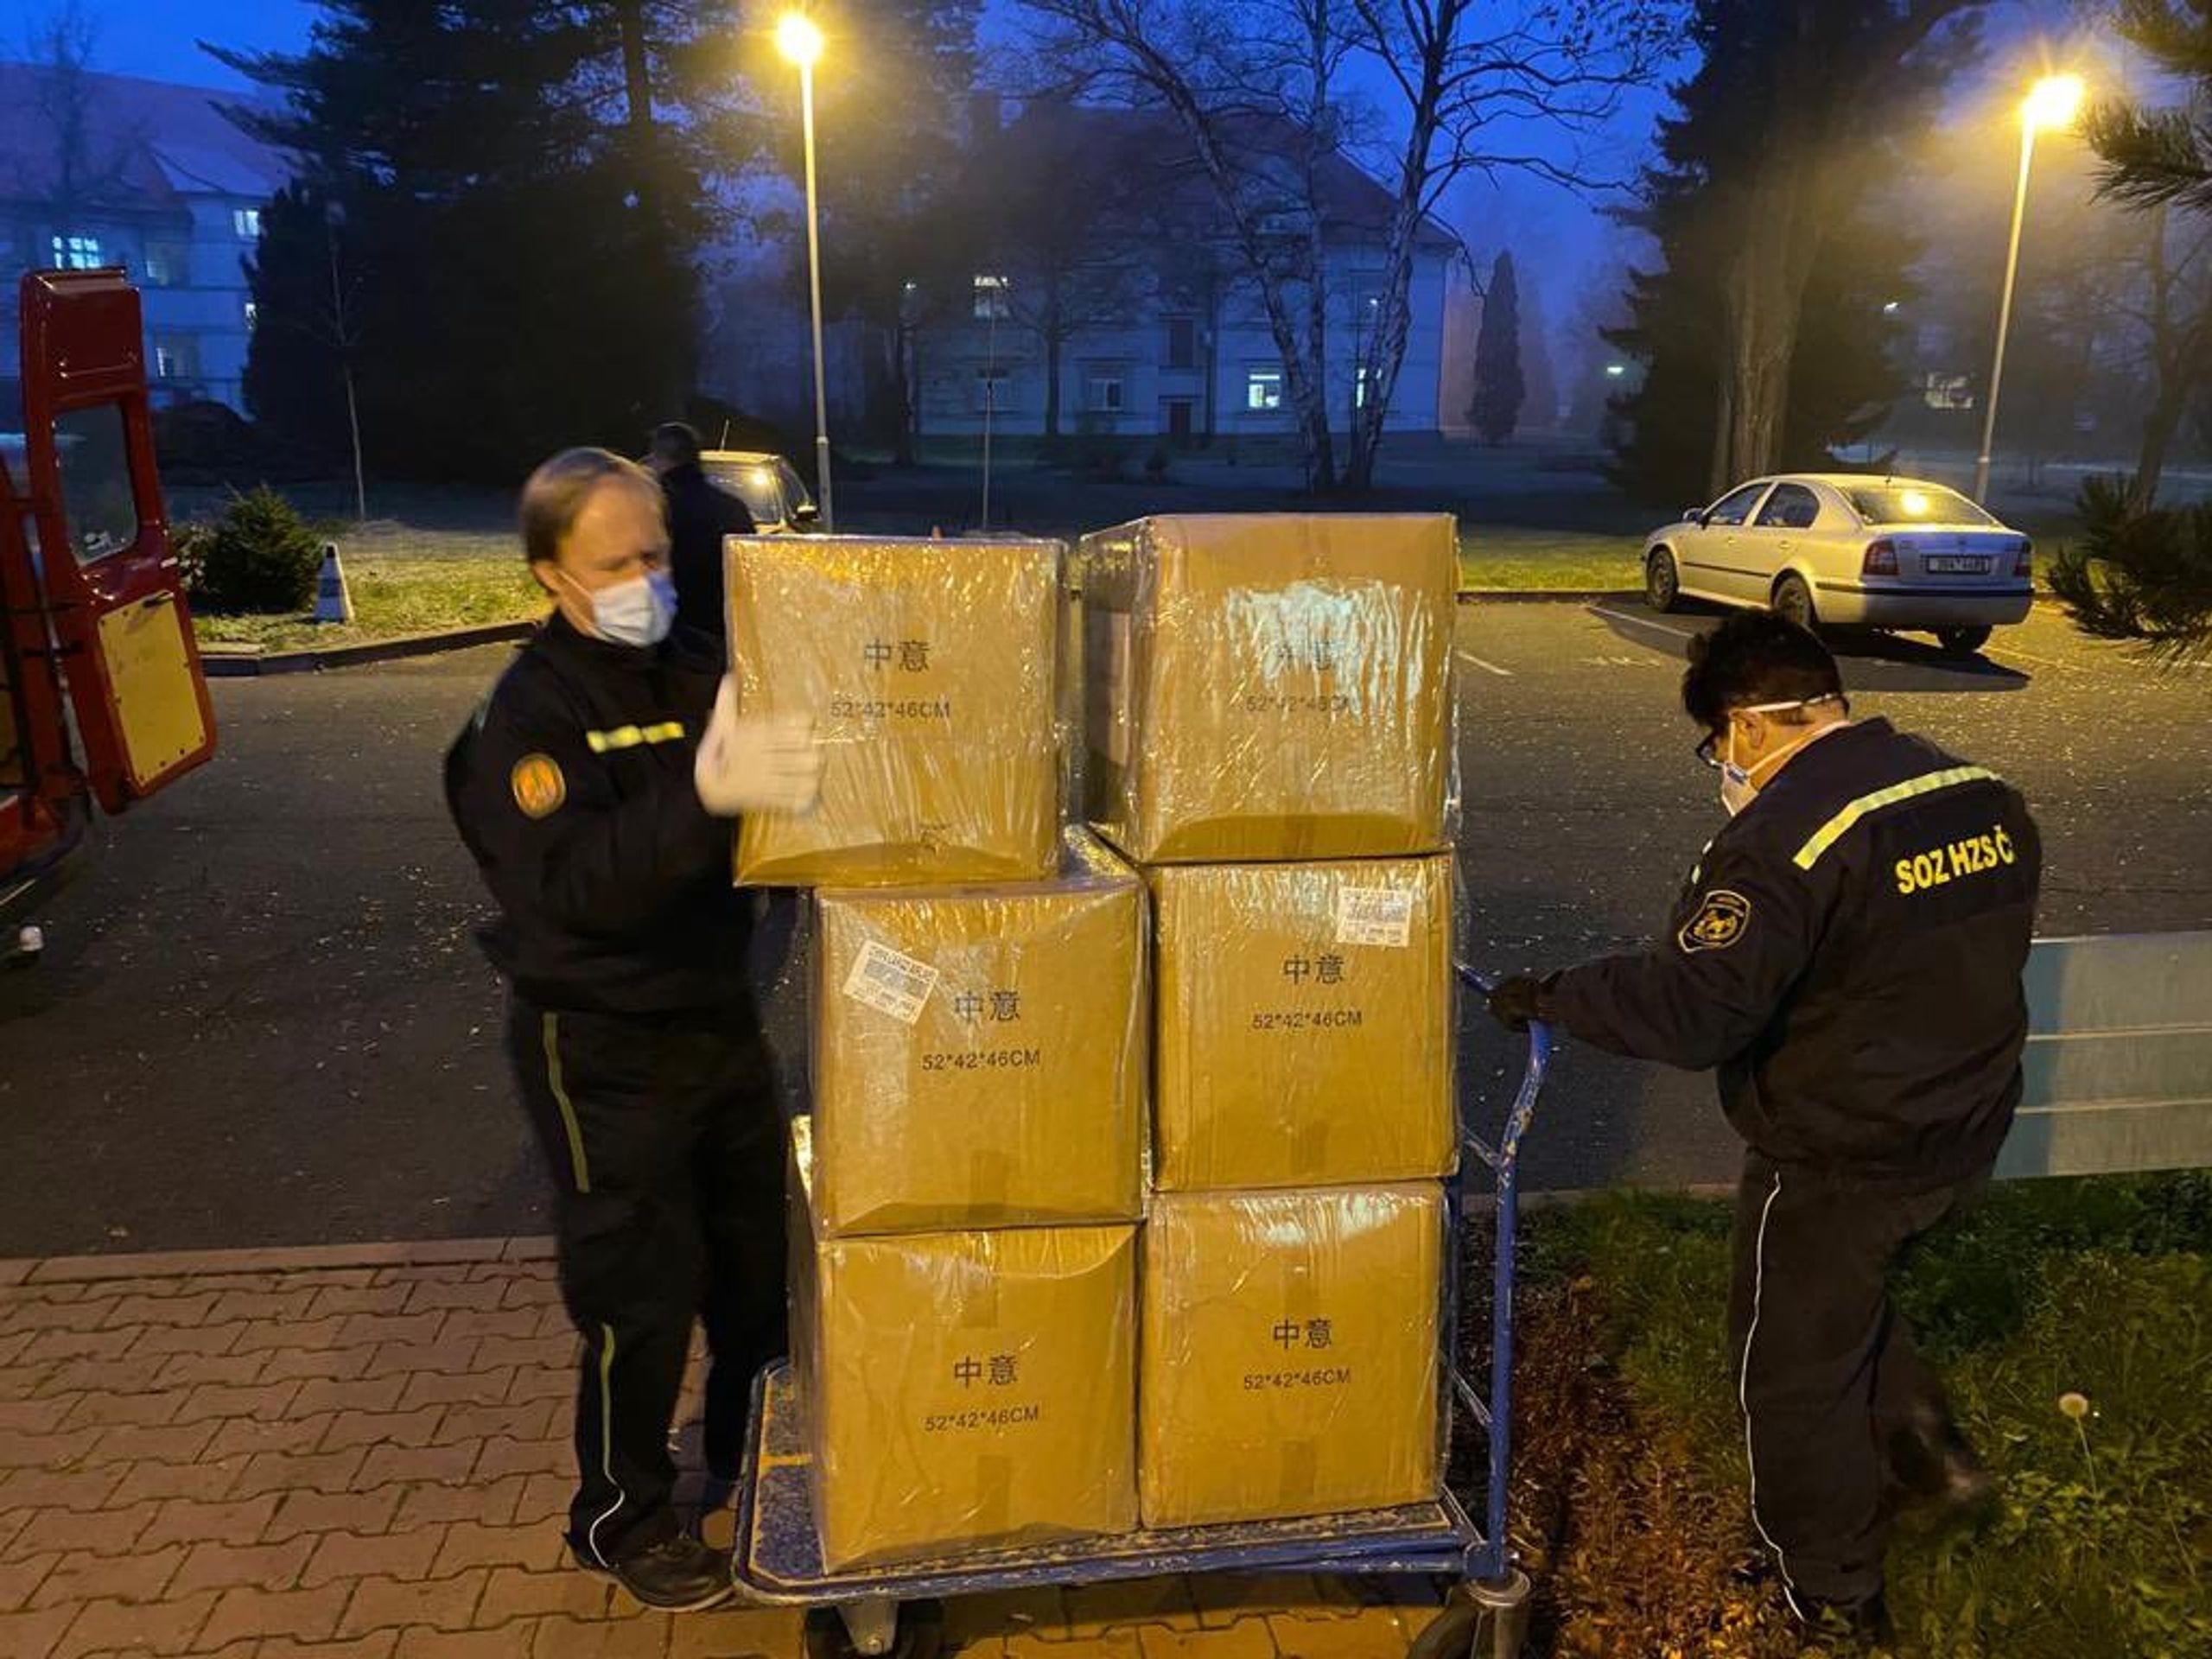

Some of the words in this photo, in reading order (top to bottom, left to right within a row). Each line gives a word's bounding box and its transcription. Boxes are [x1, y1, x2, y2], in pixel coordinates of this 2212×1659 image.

[863, 638, 931, 671] 中意
[1895, 848, 1951, 893] SOZ
[1283, 953, 1344, 985] 中意
[955, 989, 1020, 1024] 中意
[1273, 1317, 1332, 1351] 中意
[954, 1355, 1019, 1389] 中意
